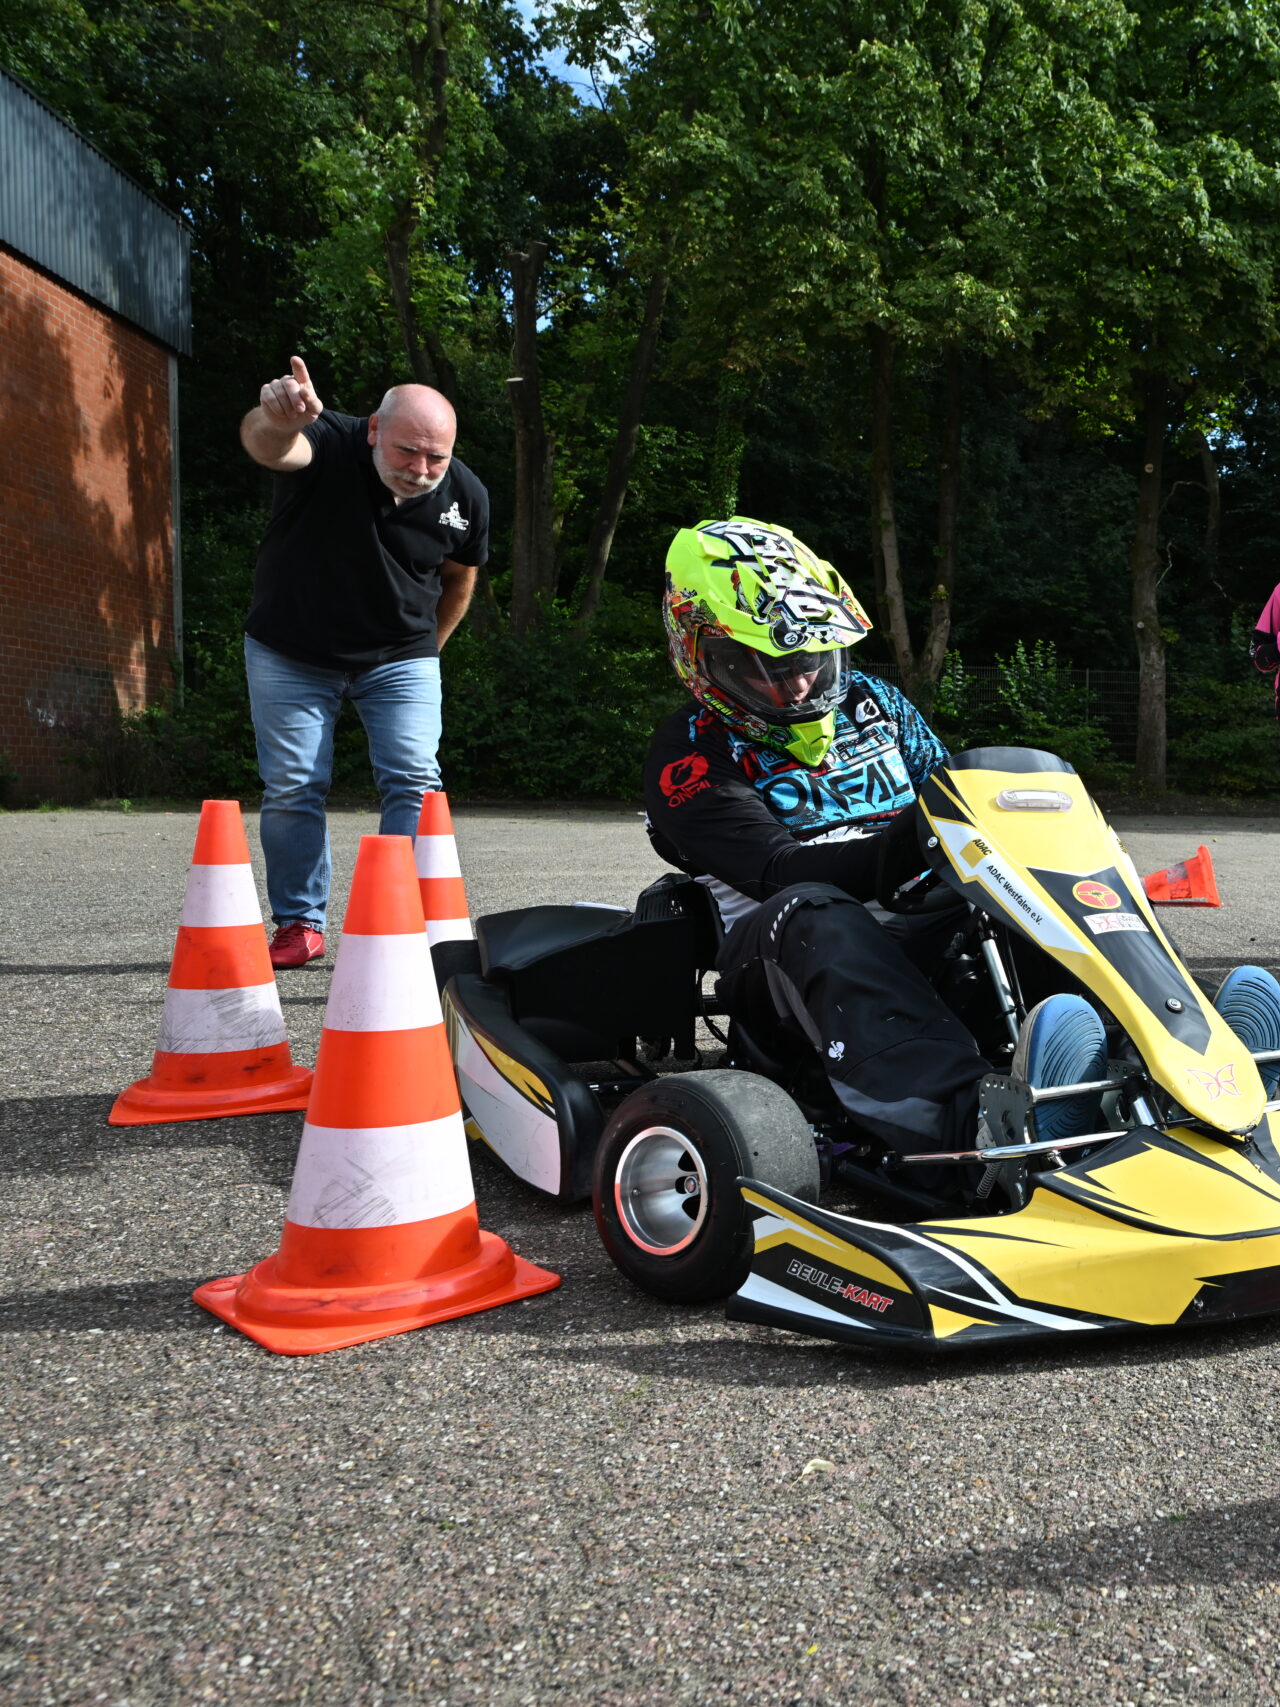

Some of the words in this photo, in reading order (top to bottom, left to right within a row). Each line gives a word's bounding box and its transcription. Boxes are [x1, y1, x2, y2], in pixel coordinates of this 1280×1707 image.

[972, 838, 992, 856] ADAC
[986, 865, 1006, 884] ADAC
[1003, 881, 1032, 914] Westfalen
[1030, 910, 1043, 925] e.V.
[786, 1258, 895, 1313] BEULE-KART
